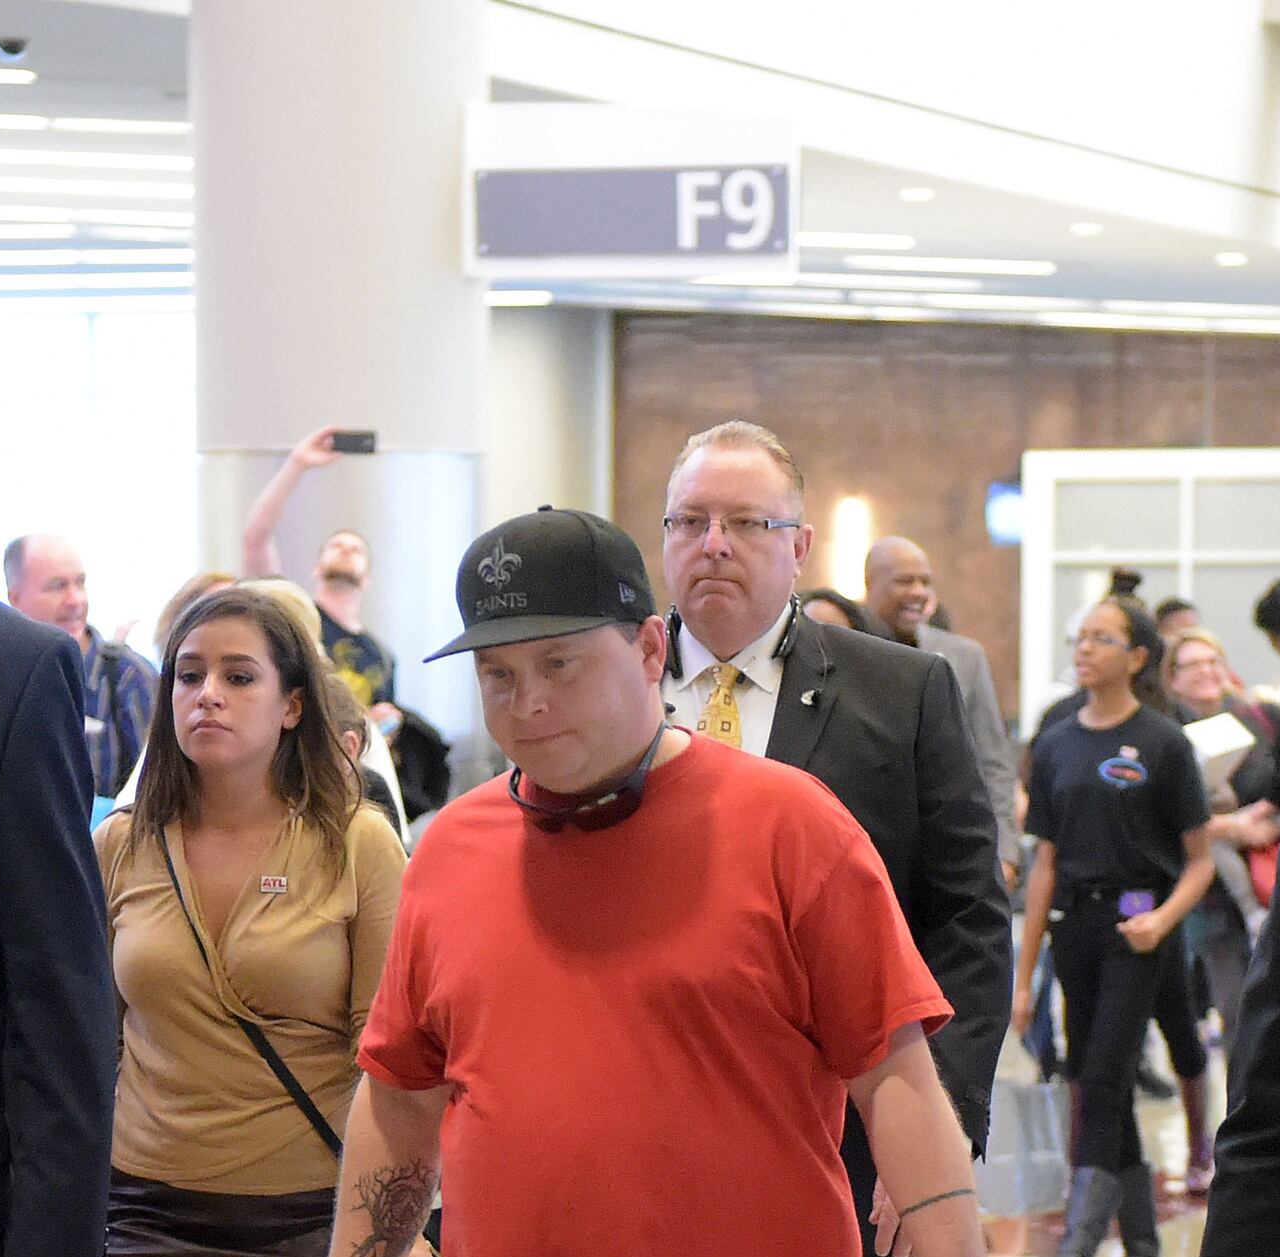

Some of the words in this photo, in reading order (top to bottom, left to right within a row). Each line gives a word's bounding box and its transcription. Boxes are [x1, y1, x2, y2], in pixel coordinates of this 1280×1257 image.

[675, 167, 776, 251] F9
[475, 592, 528, 617] SAINTS
[262, 878, 286, 888] ATL
